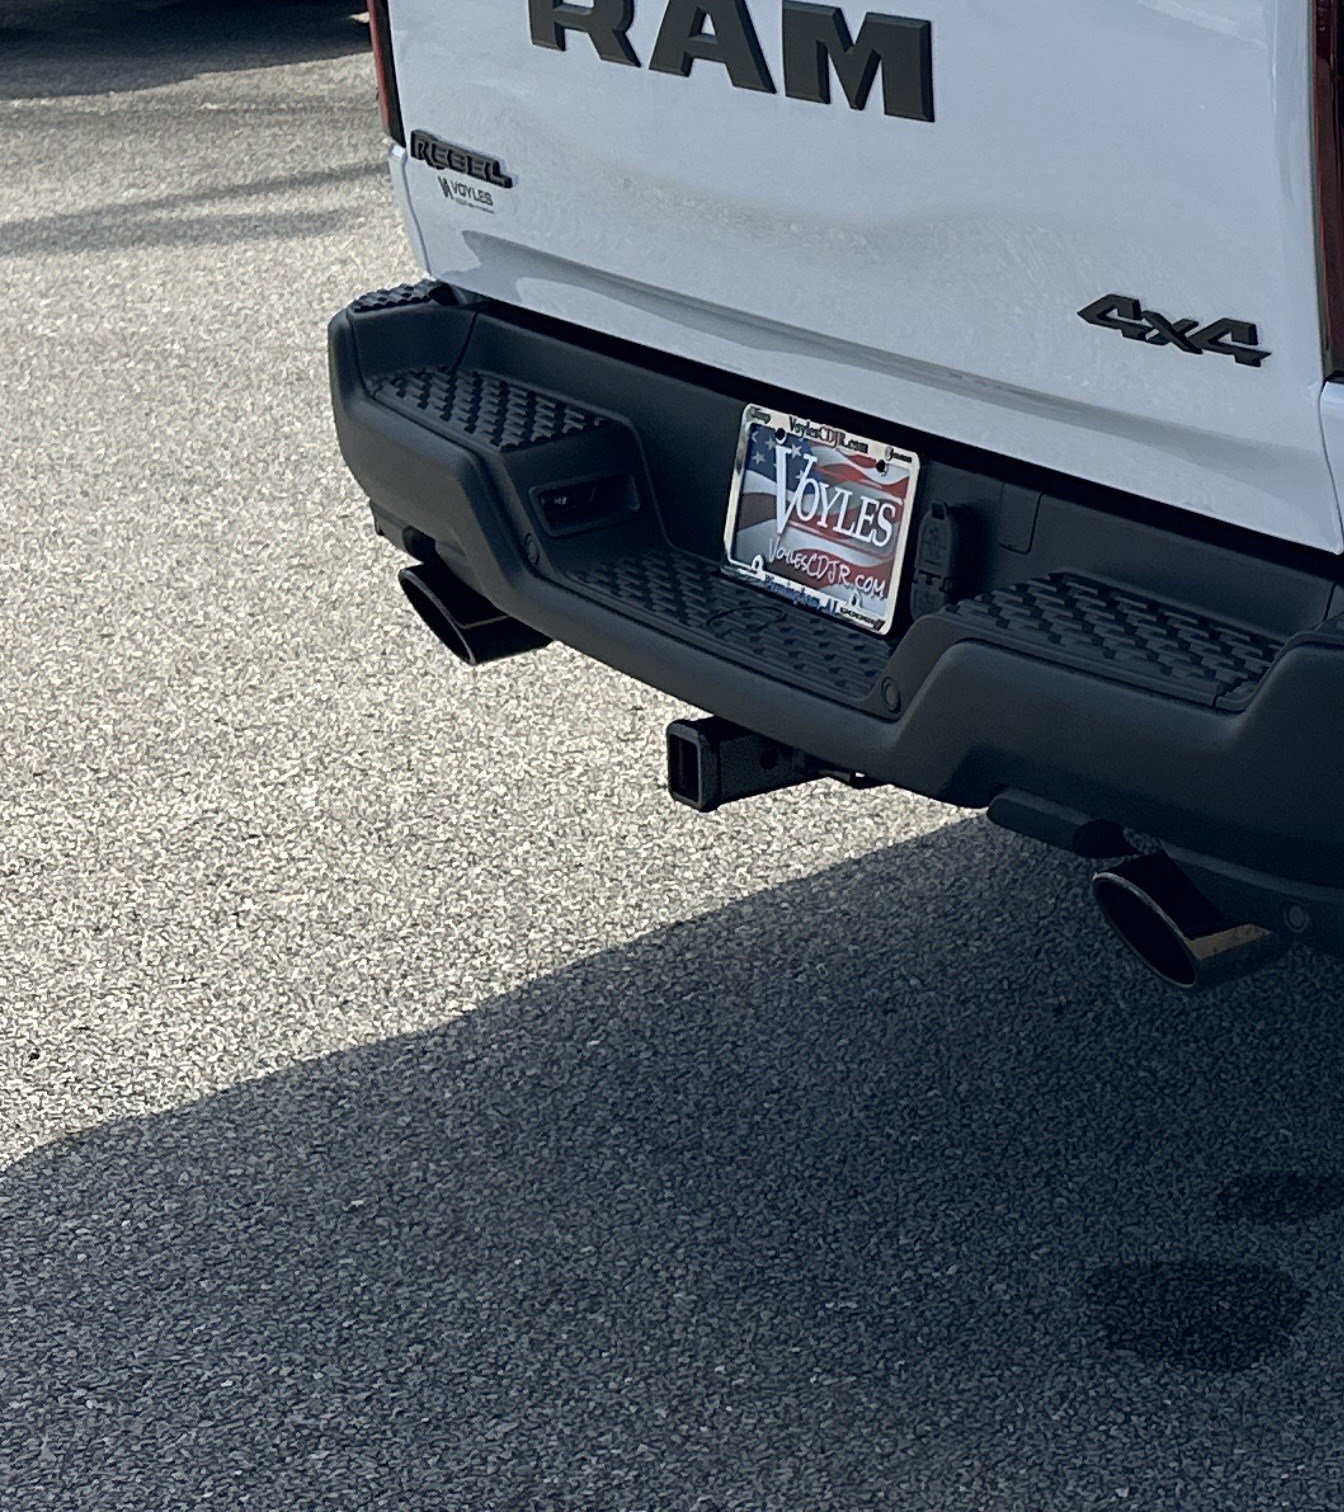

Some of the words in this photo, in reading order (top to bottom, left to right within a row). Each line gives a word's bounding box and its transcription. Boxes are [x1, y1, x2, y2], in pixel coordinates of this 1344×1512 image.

[410, 129, 514, 189] REBEL
[450, 179, 494, 207] VOYLES
[775, 445, 897, 548] VOYLES
